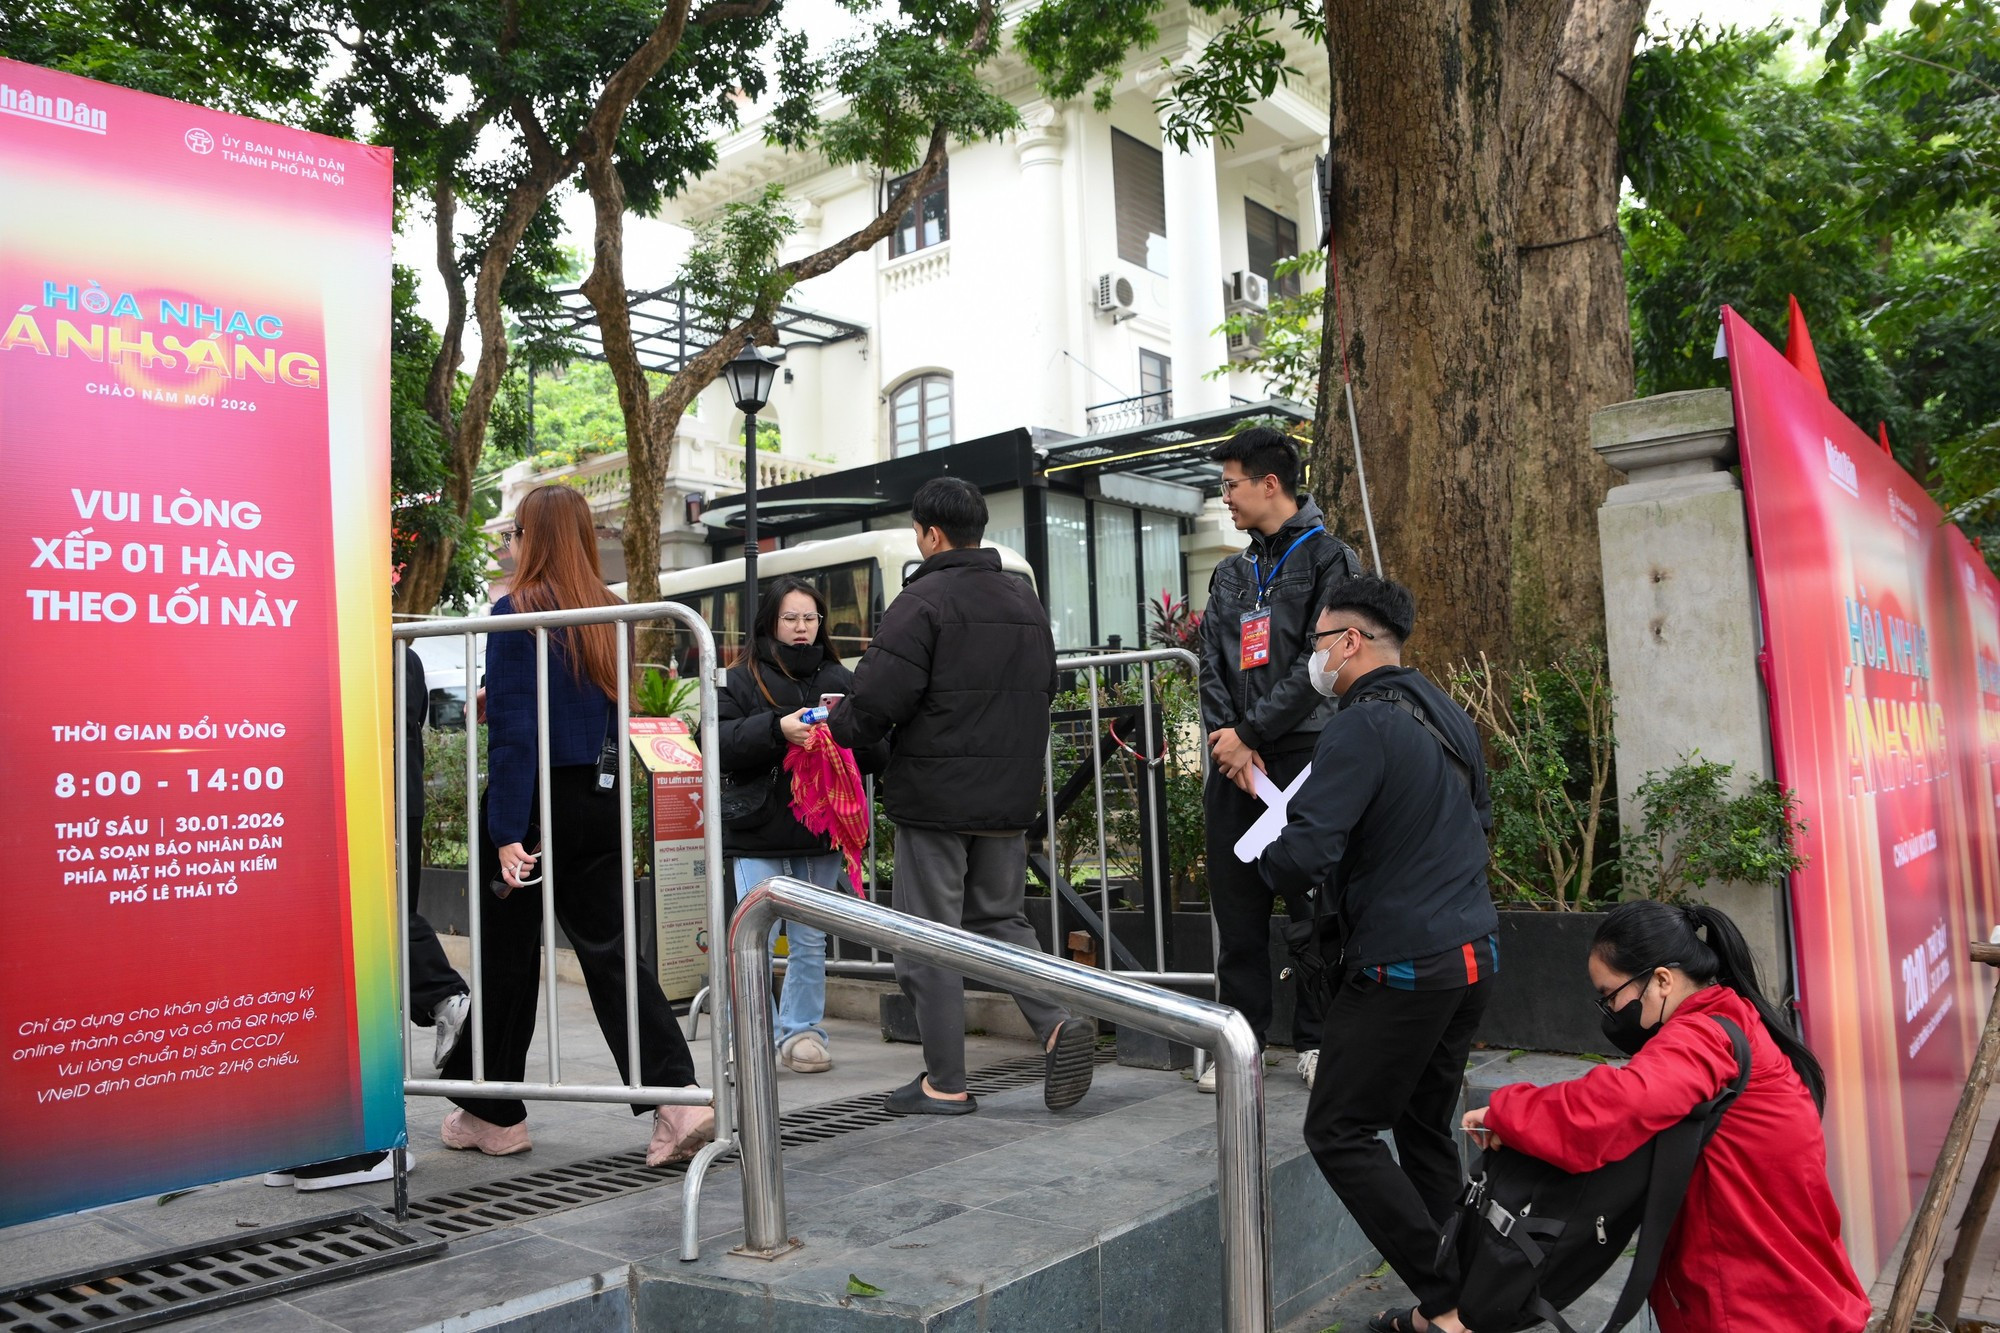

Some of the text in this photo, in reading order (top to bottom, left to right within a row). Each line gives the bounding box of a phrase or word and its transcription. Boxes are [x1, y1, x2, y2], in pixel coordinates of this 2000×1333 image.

[0, 84, 107, 130] hân Dân
[222, 133, 345, 172] ỦY BAN NHÂN DÂN
[222, 150, 344, 186] THÀNH PHỐ HÀ NỘI
[43, 279, 283, 341] HÒA NHẠC
[86, 382, 257, 412] CHÀO NĂM MỚI 2026
[71, 487, 262, 530] VUI LÒNG
[30, 527, 296, 580] XẾP 01 HÀNG
[26, 583, 298, 627] THEO LỐI NÀY
[52, 715, 286, 742] THỜI GIAN ĐỔI VÒNG
[55, 770, 141, 799] 8:00
[186, 766, 284, 793] 14:00
[55, 817, 100, 839] THỨ
[105, 815, 149, 837] SÁU
[175, 812, 285, 833] 30.01.2026
[57, 834, 283, 863] TÒA SOẠN BÁO NHÂN DÂN
[64, 853, 278, 885] PHÍA MẶT HỒ HOÀN KIẾM
[110, 876, 238, 904] PHỐ LÊ THÁI TỔ
[18, 985, 316, 1037] Chỉ áp dụng cho khán giả đã đăng ký
[12, 1007, 318, 1061] online thành công và có mã QR hợp lệ.
[58, 1032, 286, 1077] Vui lòng chuẩn bị sẵn CCCD/
[36, 1051, 302, 1104] VNeID định danh mức 2/Hộ chiếu,
